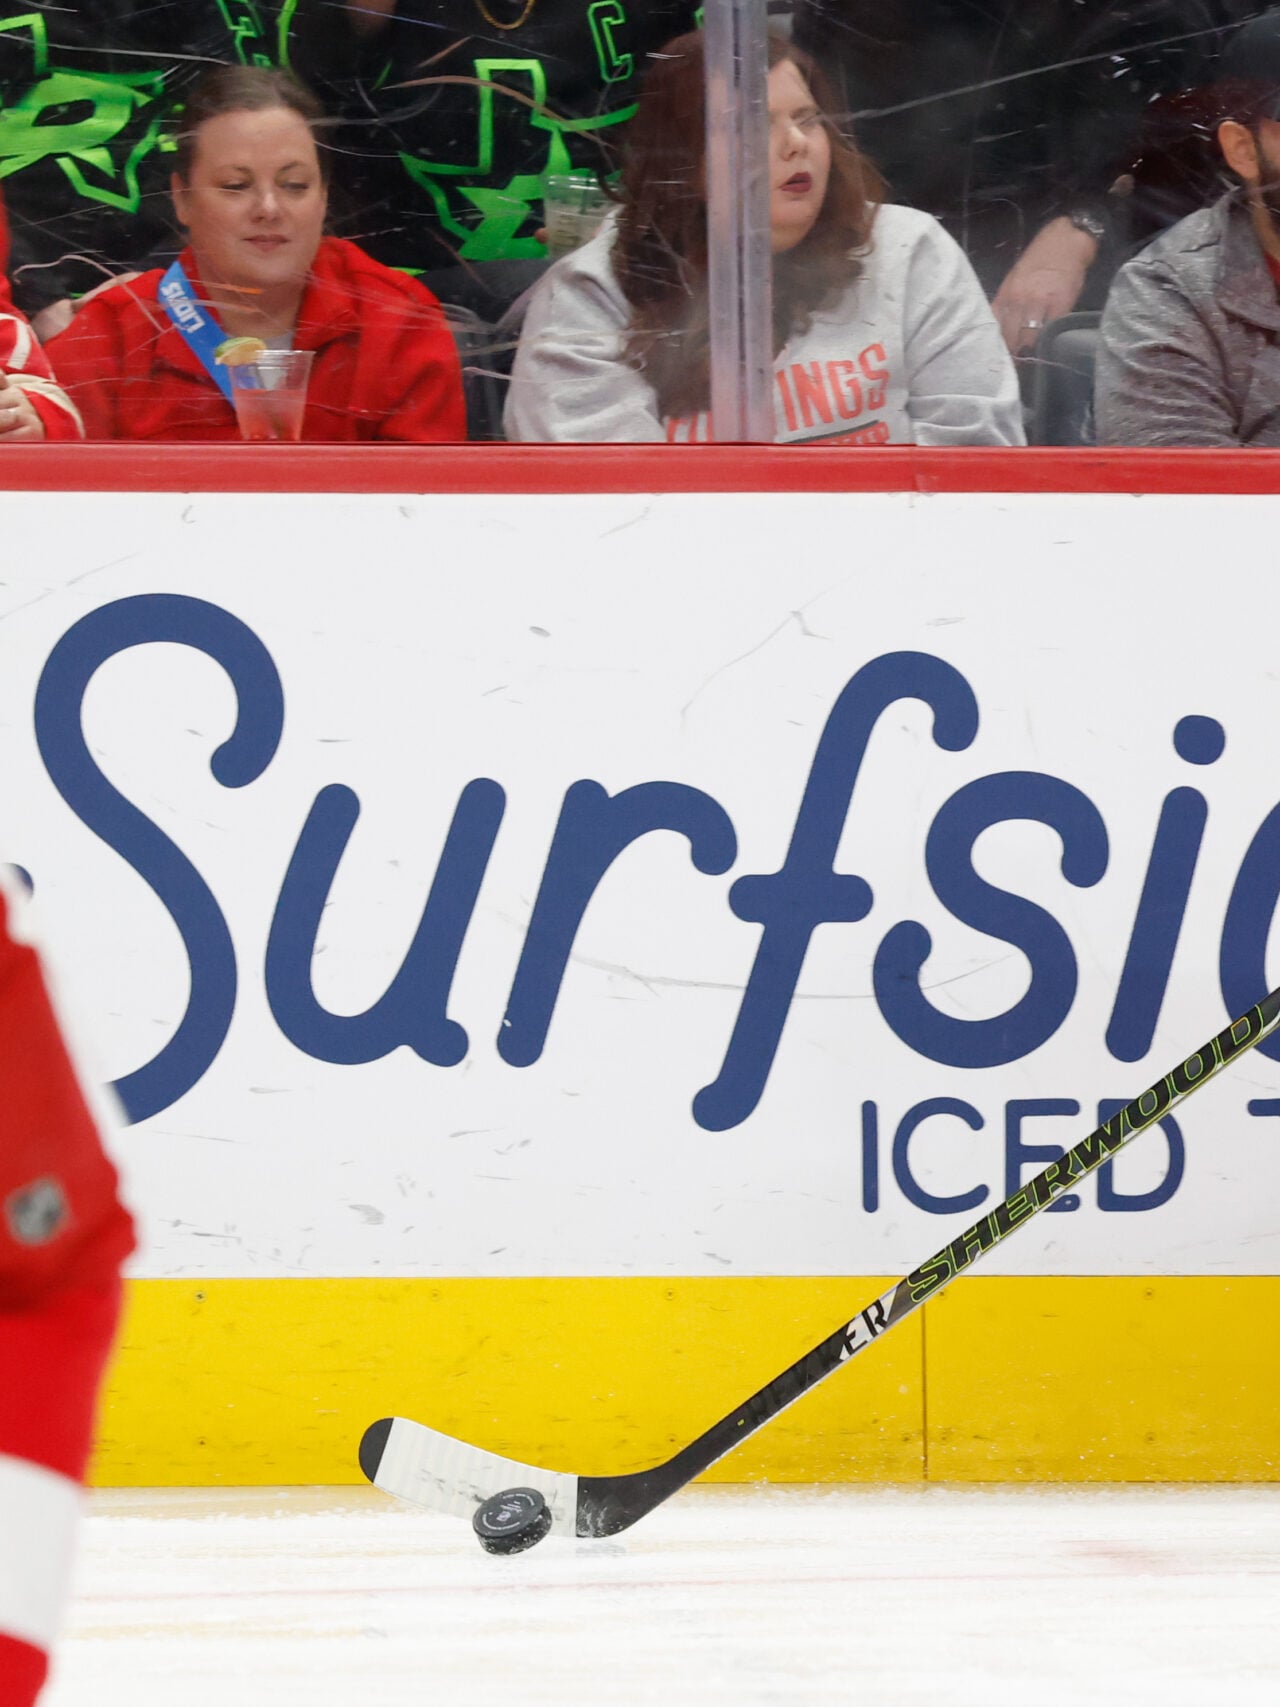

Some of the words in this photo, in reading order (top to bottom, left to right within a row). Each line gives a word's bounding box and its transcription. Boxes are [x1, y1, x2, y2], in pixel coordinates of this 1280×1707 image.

[776, 343, 889, 432] INGS
[861, 1097, 1186, 1214] ICED
[907, 1004, 1264, 1303] SHERWOOD
